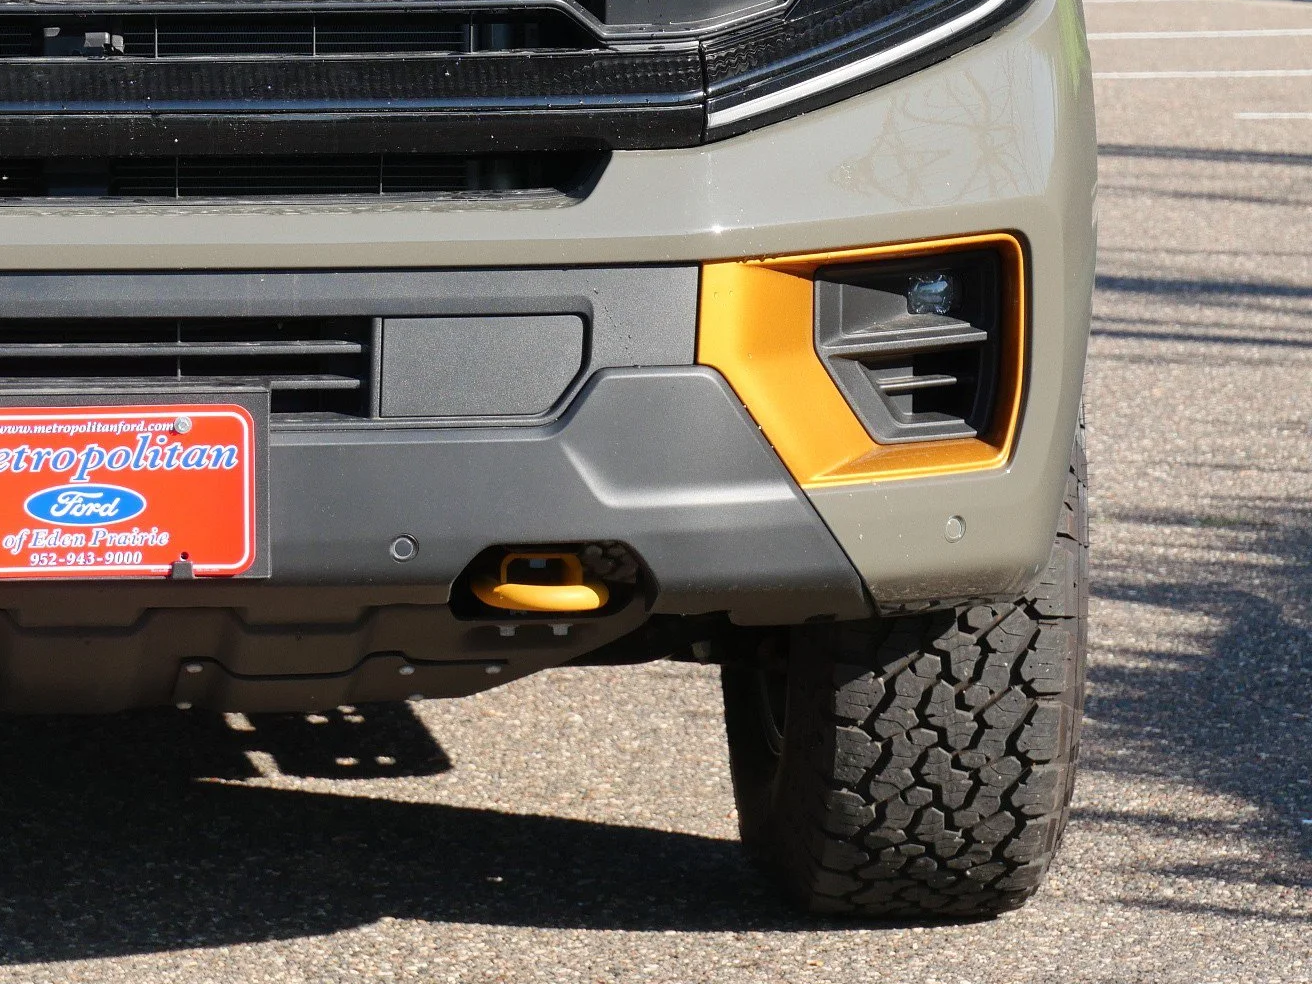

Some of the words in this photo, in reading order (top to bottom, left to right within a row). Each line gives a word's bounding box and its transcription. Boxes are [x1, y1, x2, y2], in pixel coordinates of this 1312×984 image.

[49, 491, 120, 517] Ford
[2, 528, 28, 554] of
[31, 529, 86, 548] Eden
[91, 527, 169, 547] Prairie
[31, 551, 142, 566] 952-943-9000
